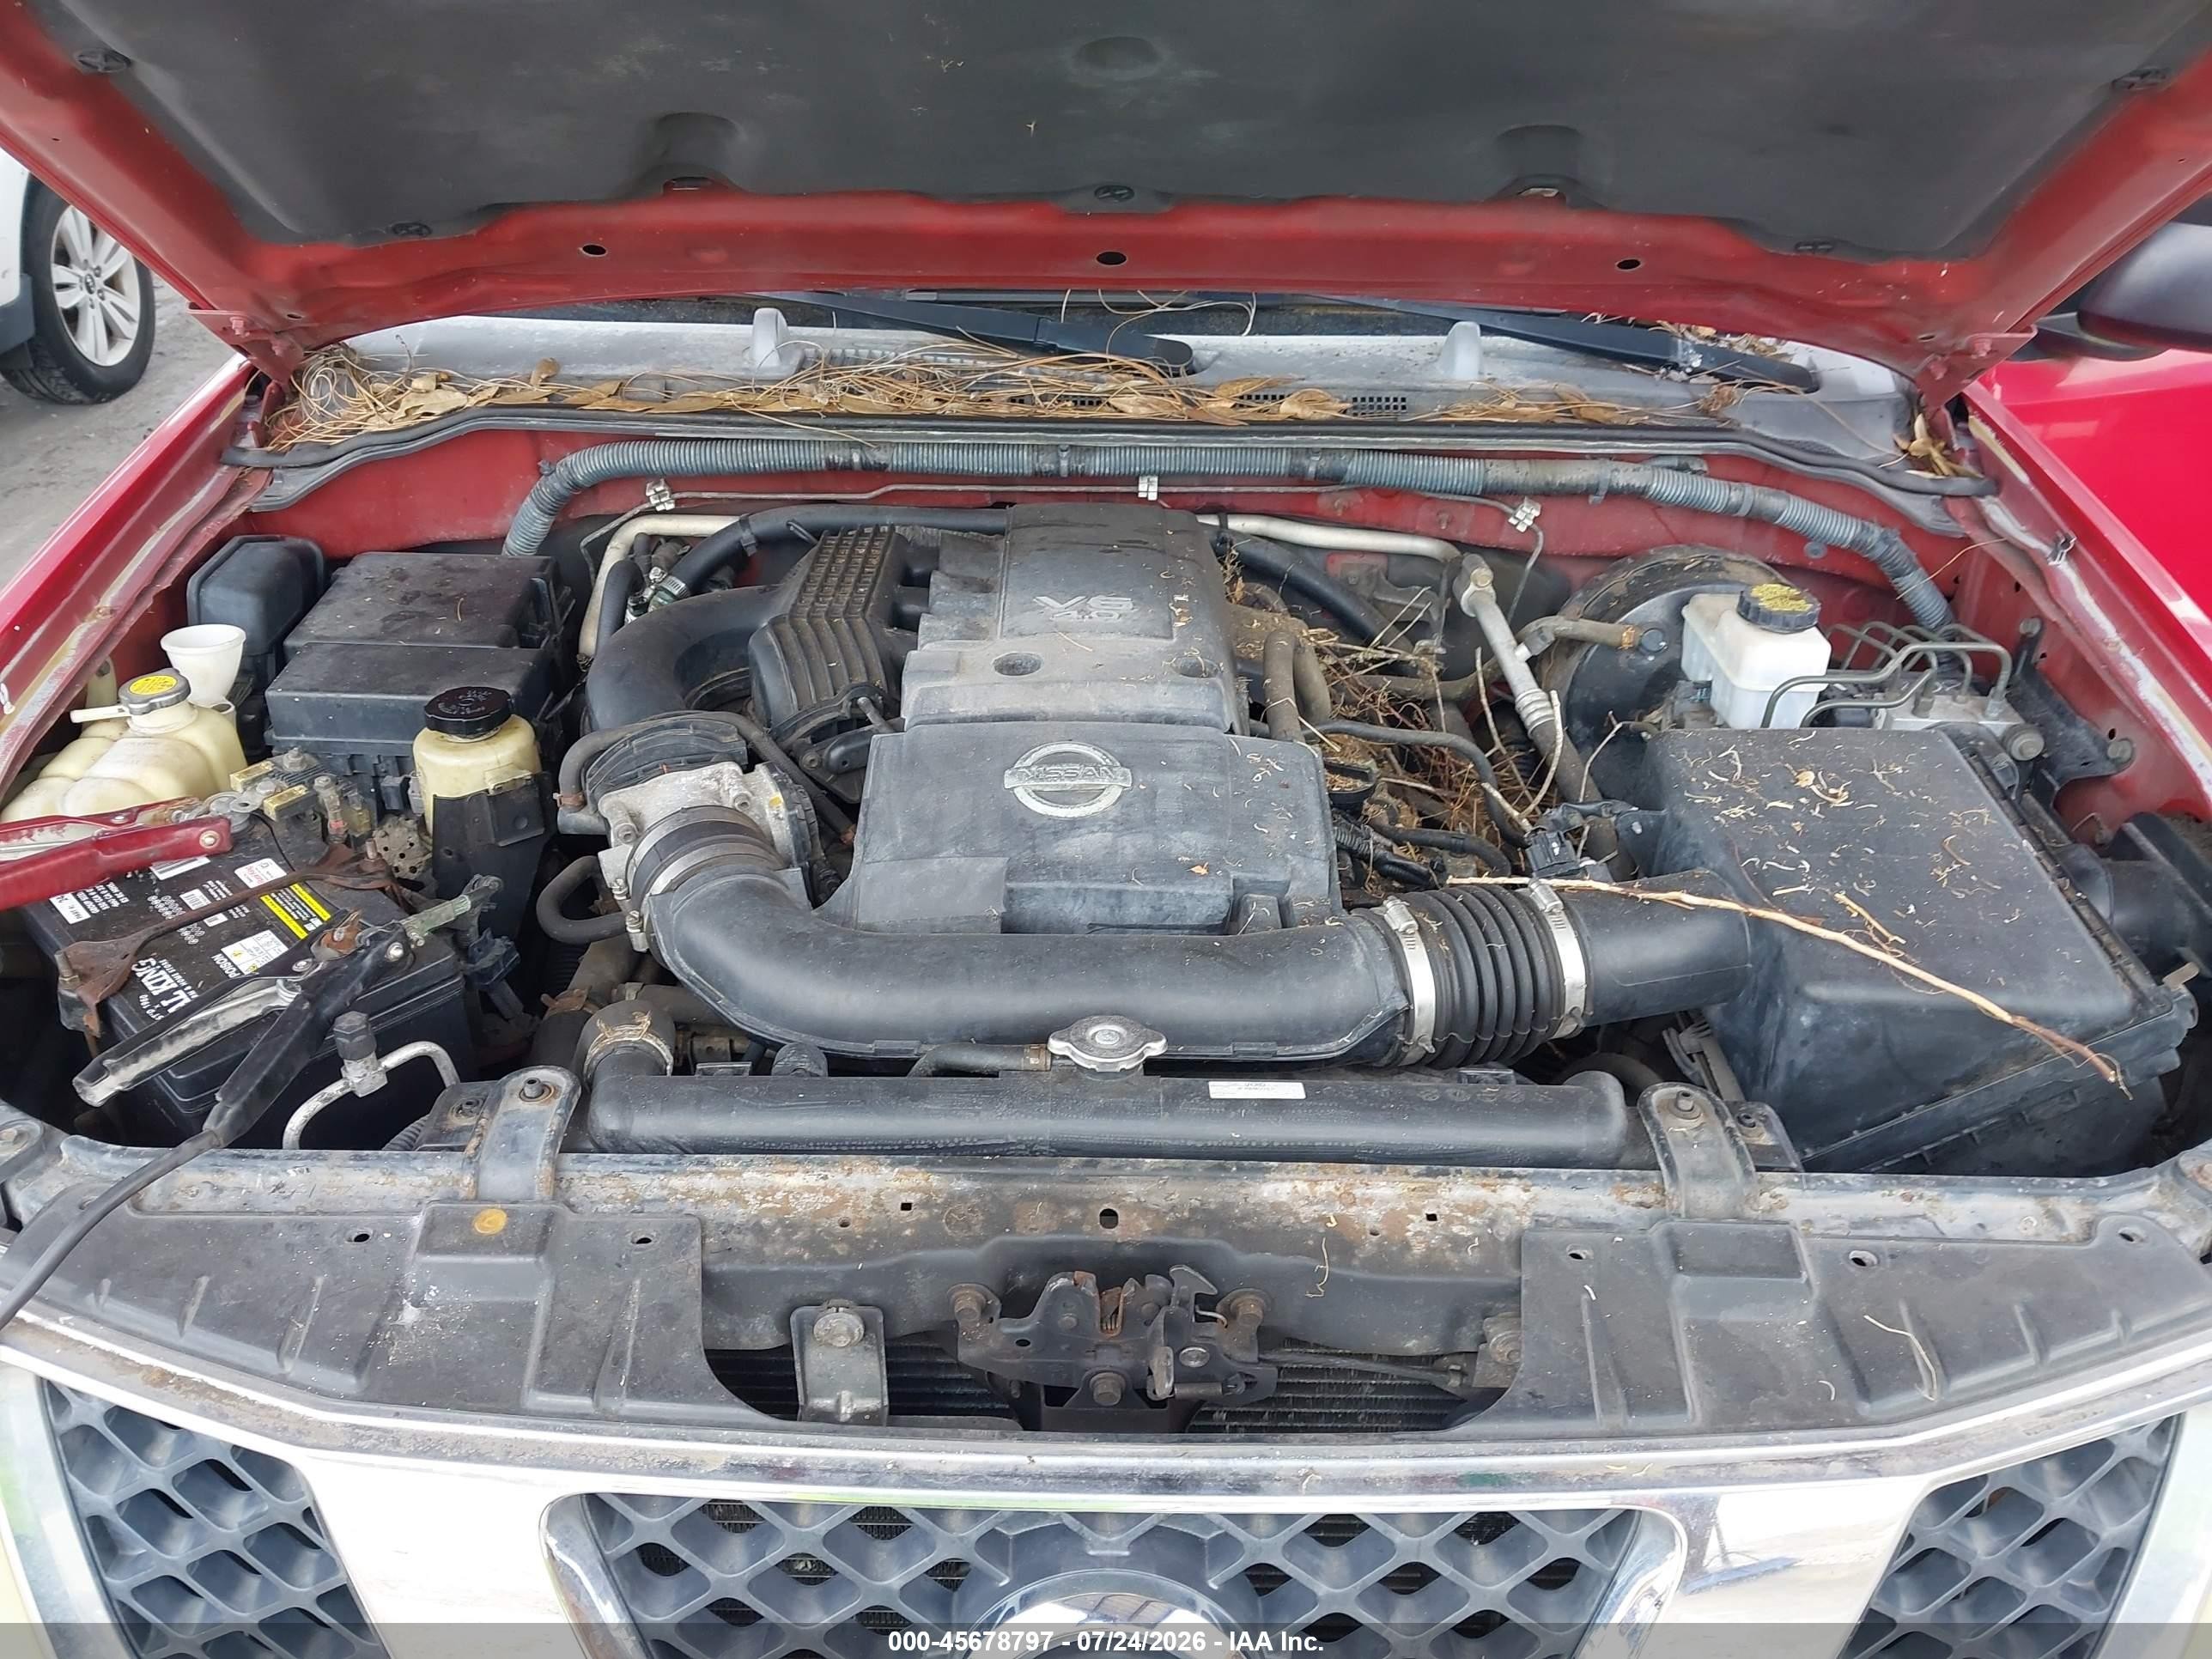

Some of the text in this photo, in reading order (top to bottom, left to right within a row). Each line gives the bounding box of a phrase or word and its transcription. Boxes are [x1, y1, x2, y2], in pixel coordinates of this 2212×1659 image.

[1033, 595, 1133, 610] V6
[1018, 765, 1117, 779] NISSAN
[211, 954, 240, 979] POISON
[131, 957, 178, 995] KING
[146, 1009, 165, 1020] ST'D
